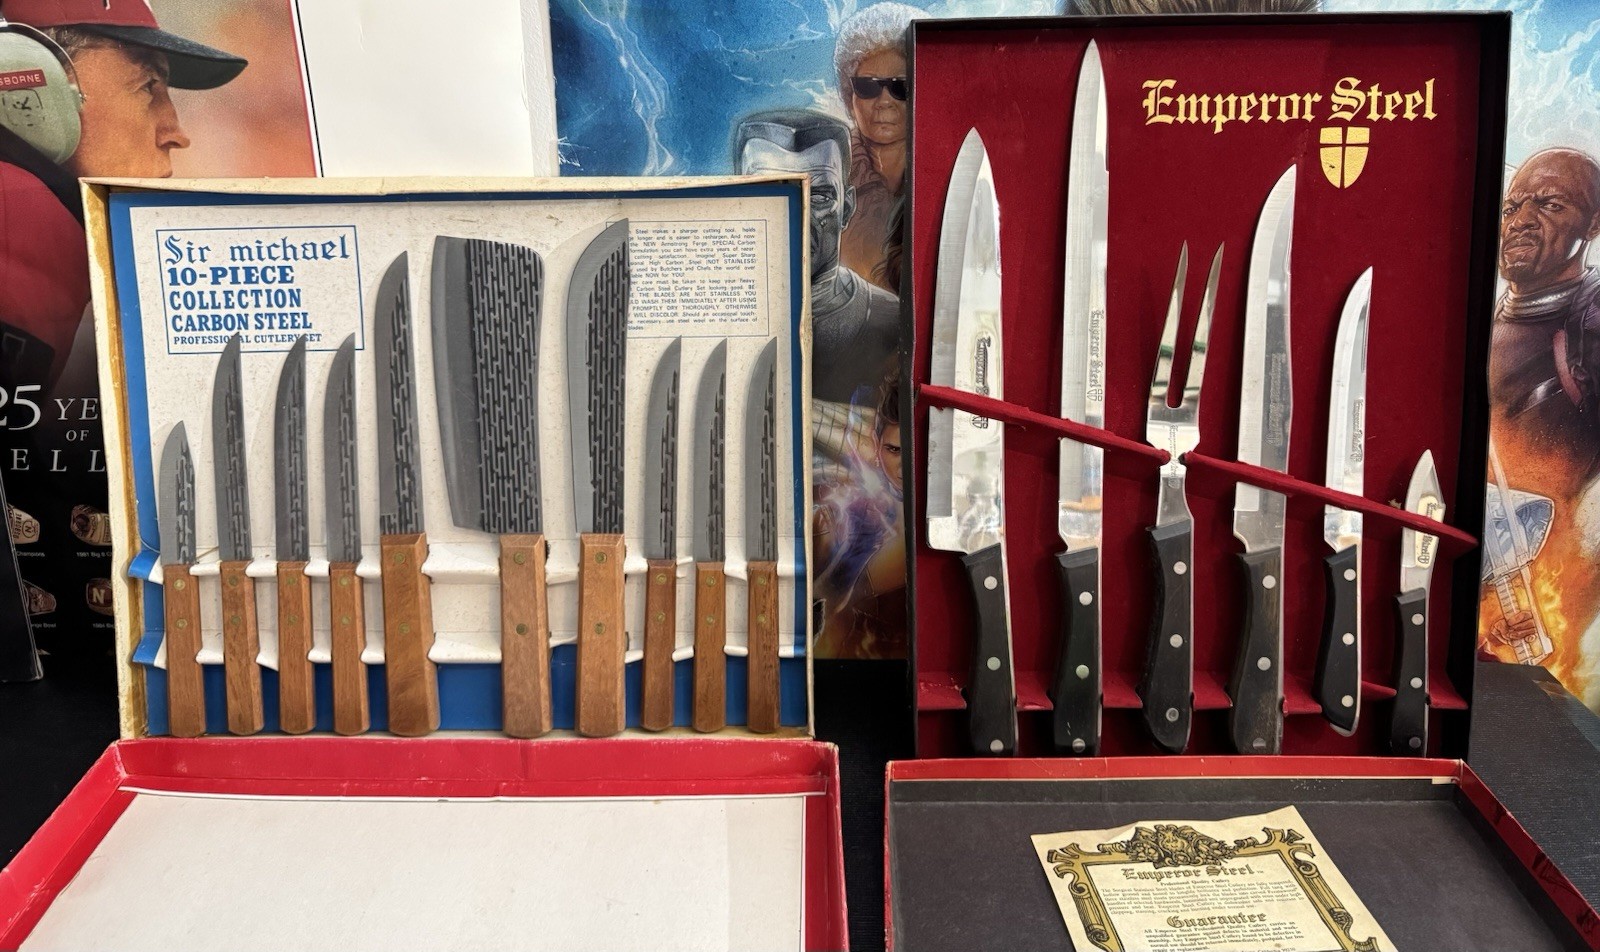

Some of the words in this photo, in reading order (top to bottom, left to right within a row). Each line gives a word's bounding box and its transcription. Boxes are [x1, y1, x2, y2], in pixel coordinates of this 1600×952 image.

[1142, 79, 1322, 134] Emperor
[1328, 77, 1438, 121] Steel
[164, 235, 211, 265] Sir
[229, 234, 350, 262] michael
[167, 265, 294, 286] 10-PIECE
[169, 288, 302, 310] COLLECTION
[171, 313, 249, 332] CARBON
[254, 312, 312, 330] STEEL
[173, 334, 251, 345] PROFESSIOAL
[254, 334, 300, 344] CUTLERY
[1089, 310, 1104, 357] Emperor
[1089, 360, 1103, 387] Steel
[54, 398, 98, 420] YE
[66, 430, 89, 441] OF
[1121, 866, 1201, 882] Emperor
[1206, 863, 1255, 877] Steel
[1166, 911, 1267, 928] Guarantee
